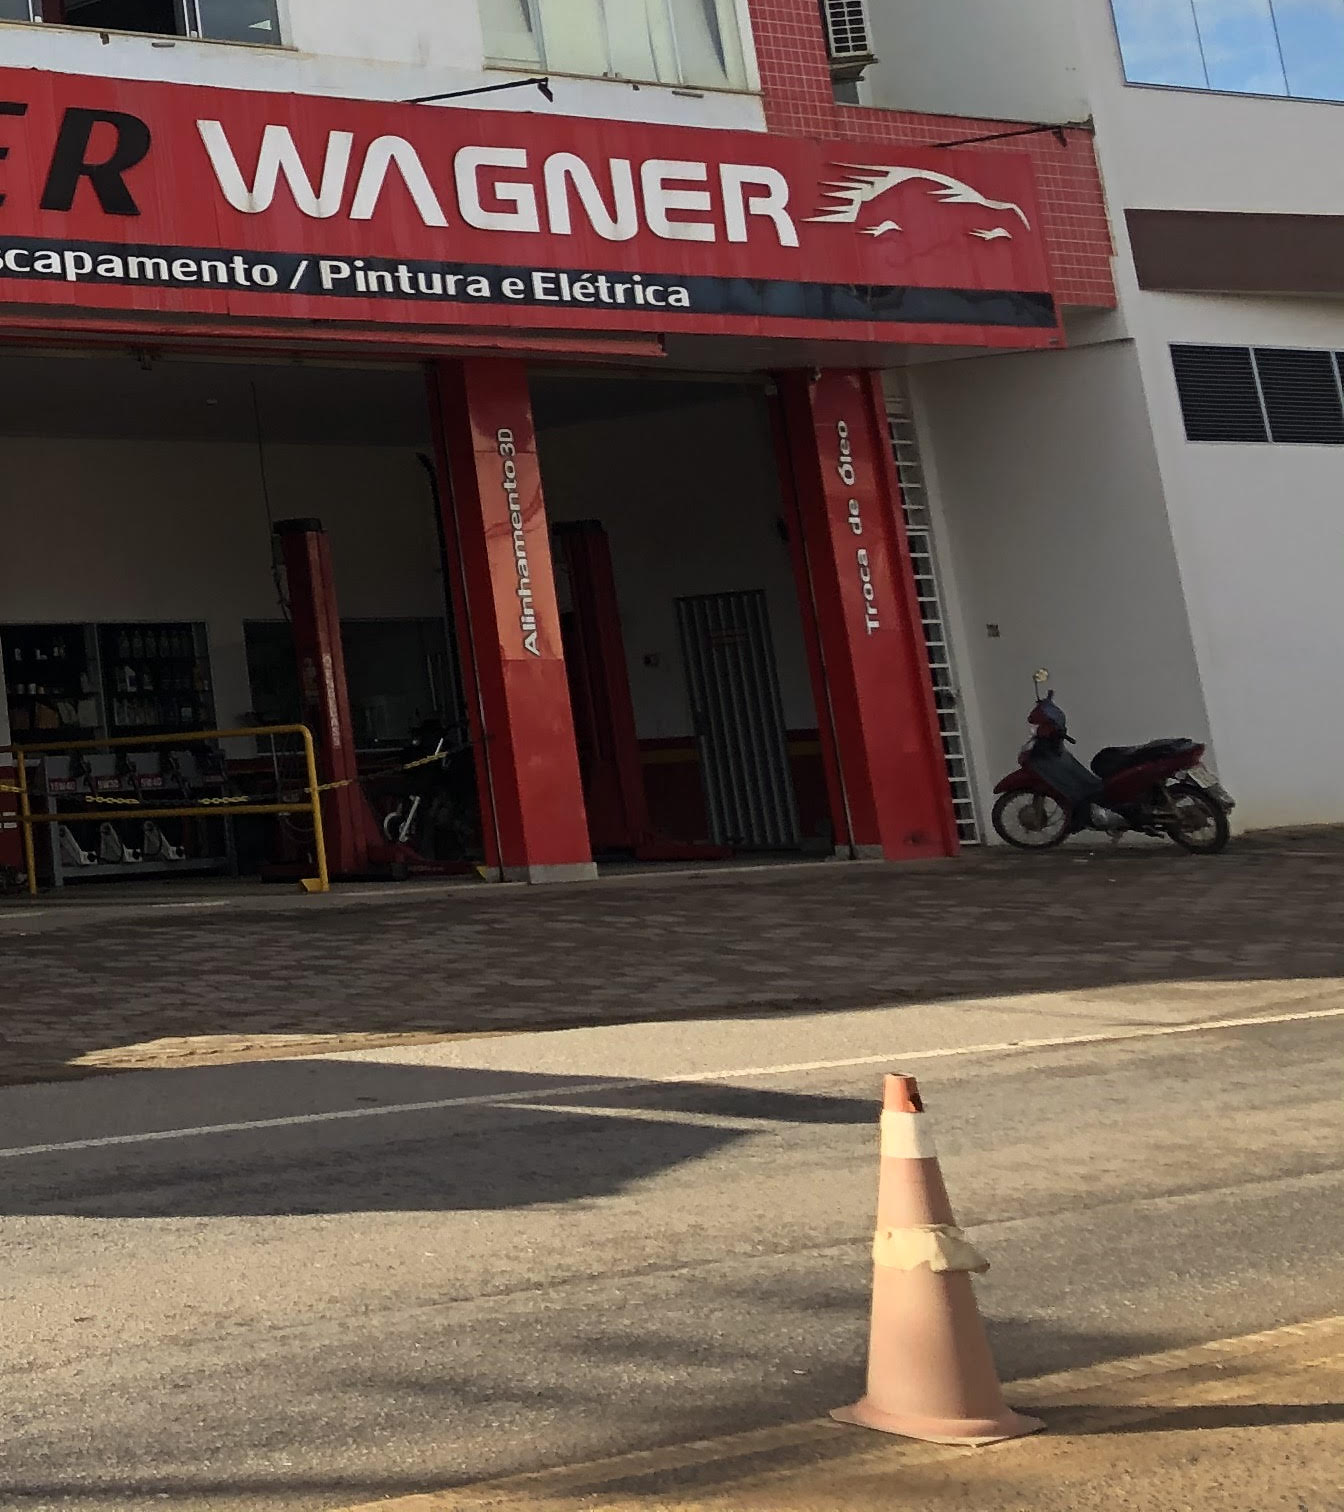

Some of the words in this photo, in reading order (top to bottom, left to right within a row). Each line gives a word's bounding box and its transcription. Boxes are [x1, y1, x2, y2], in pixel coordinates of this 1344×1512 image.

[196, 119, 800, 247] WAGNER
[319, 259, 491, 299] Pintura
[500, 277, 526, 301] e
[532, 271, 692, 309] Elétrica
[497, 427, 516, 457] 3D
[837, 419, 856, 486] Óleo
[848, 498, 863, 535] de
[502, 460, 541, 657] Alinhamento
[857, 548, 880, 636] Troca
